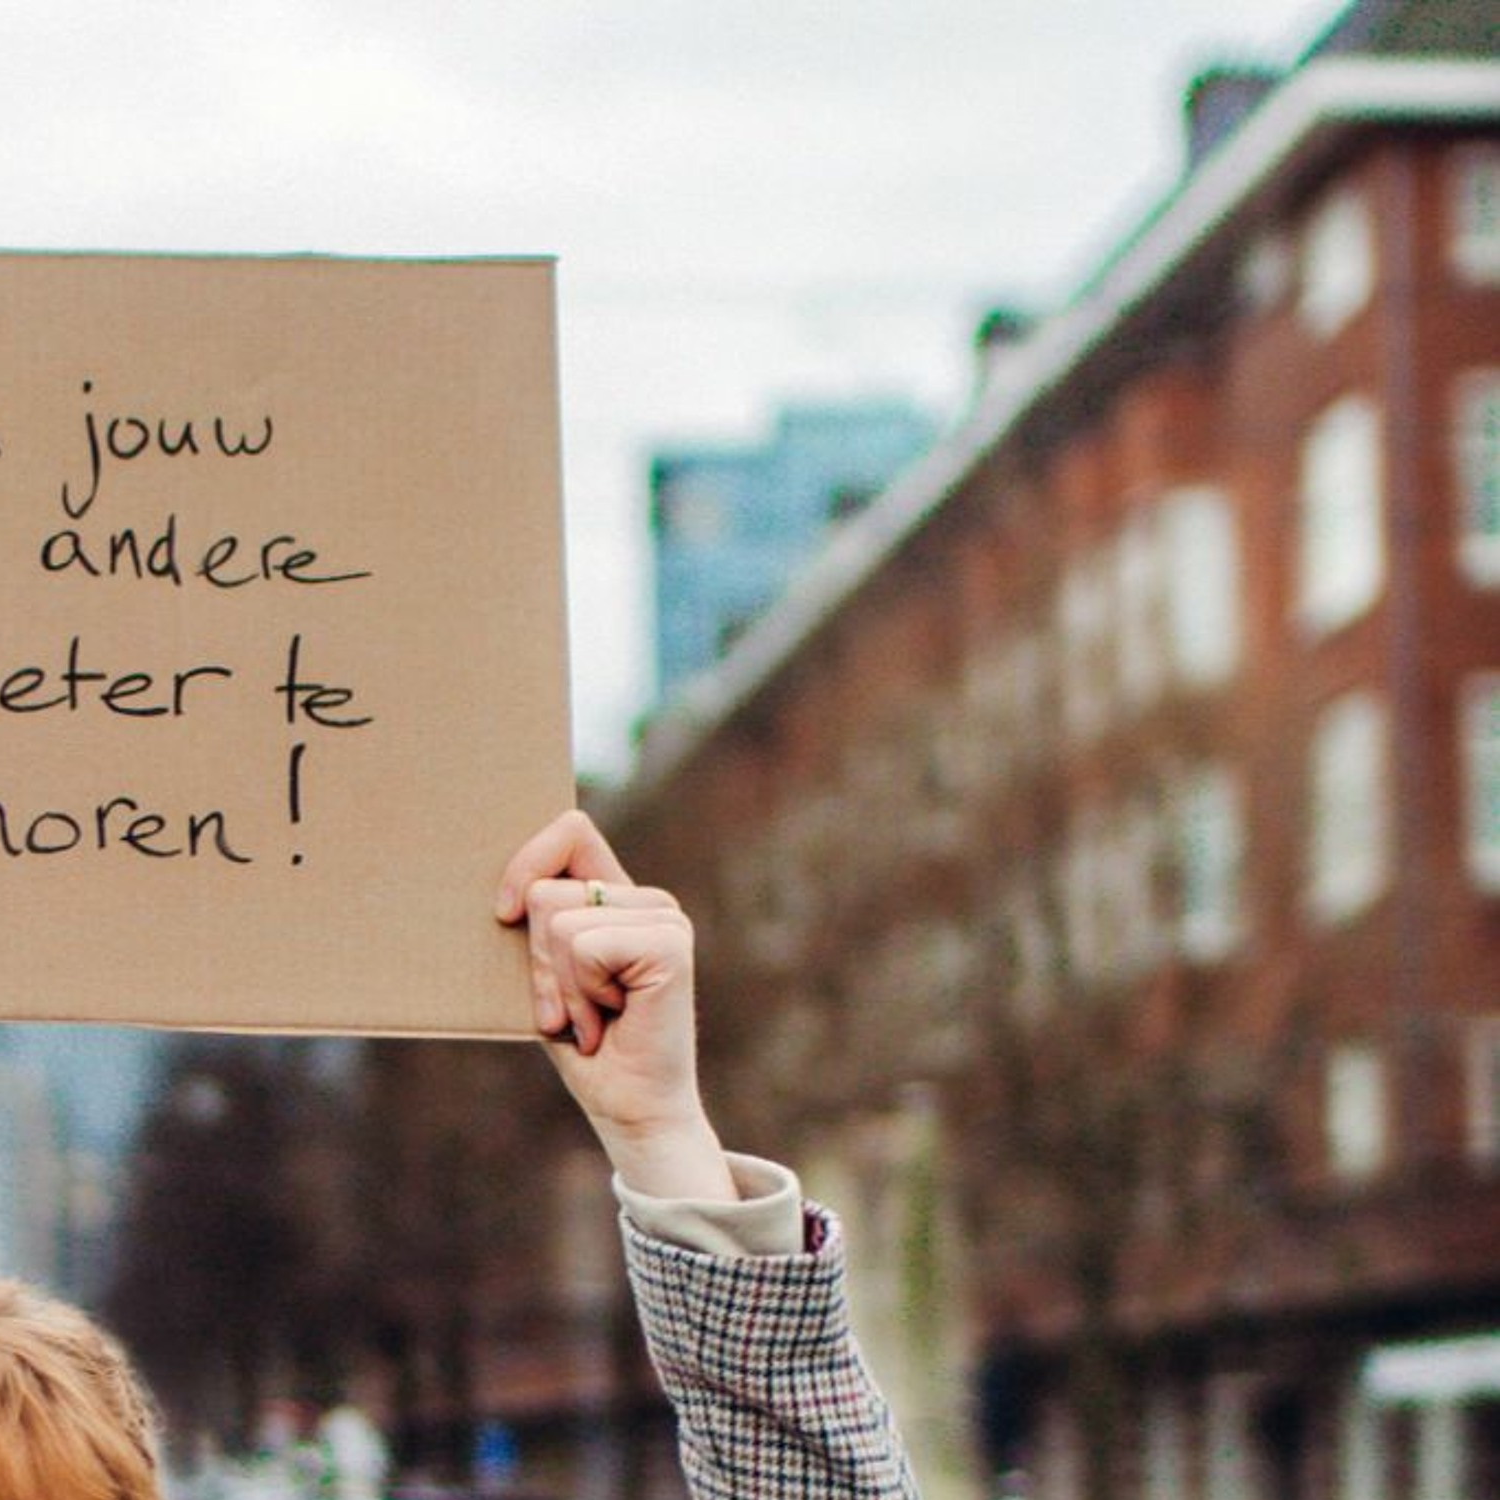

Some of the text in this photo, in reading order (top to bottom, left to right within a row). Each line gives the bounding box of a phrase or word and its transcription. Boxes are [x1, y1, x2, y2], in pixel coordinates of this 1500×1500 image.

[61, 380, 274, 521] jouw
[40, 514, 374, 588] andere
[274, 633, 375, 729] te
